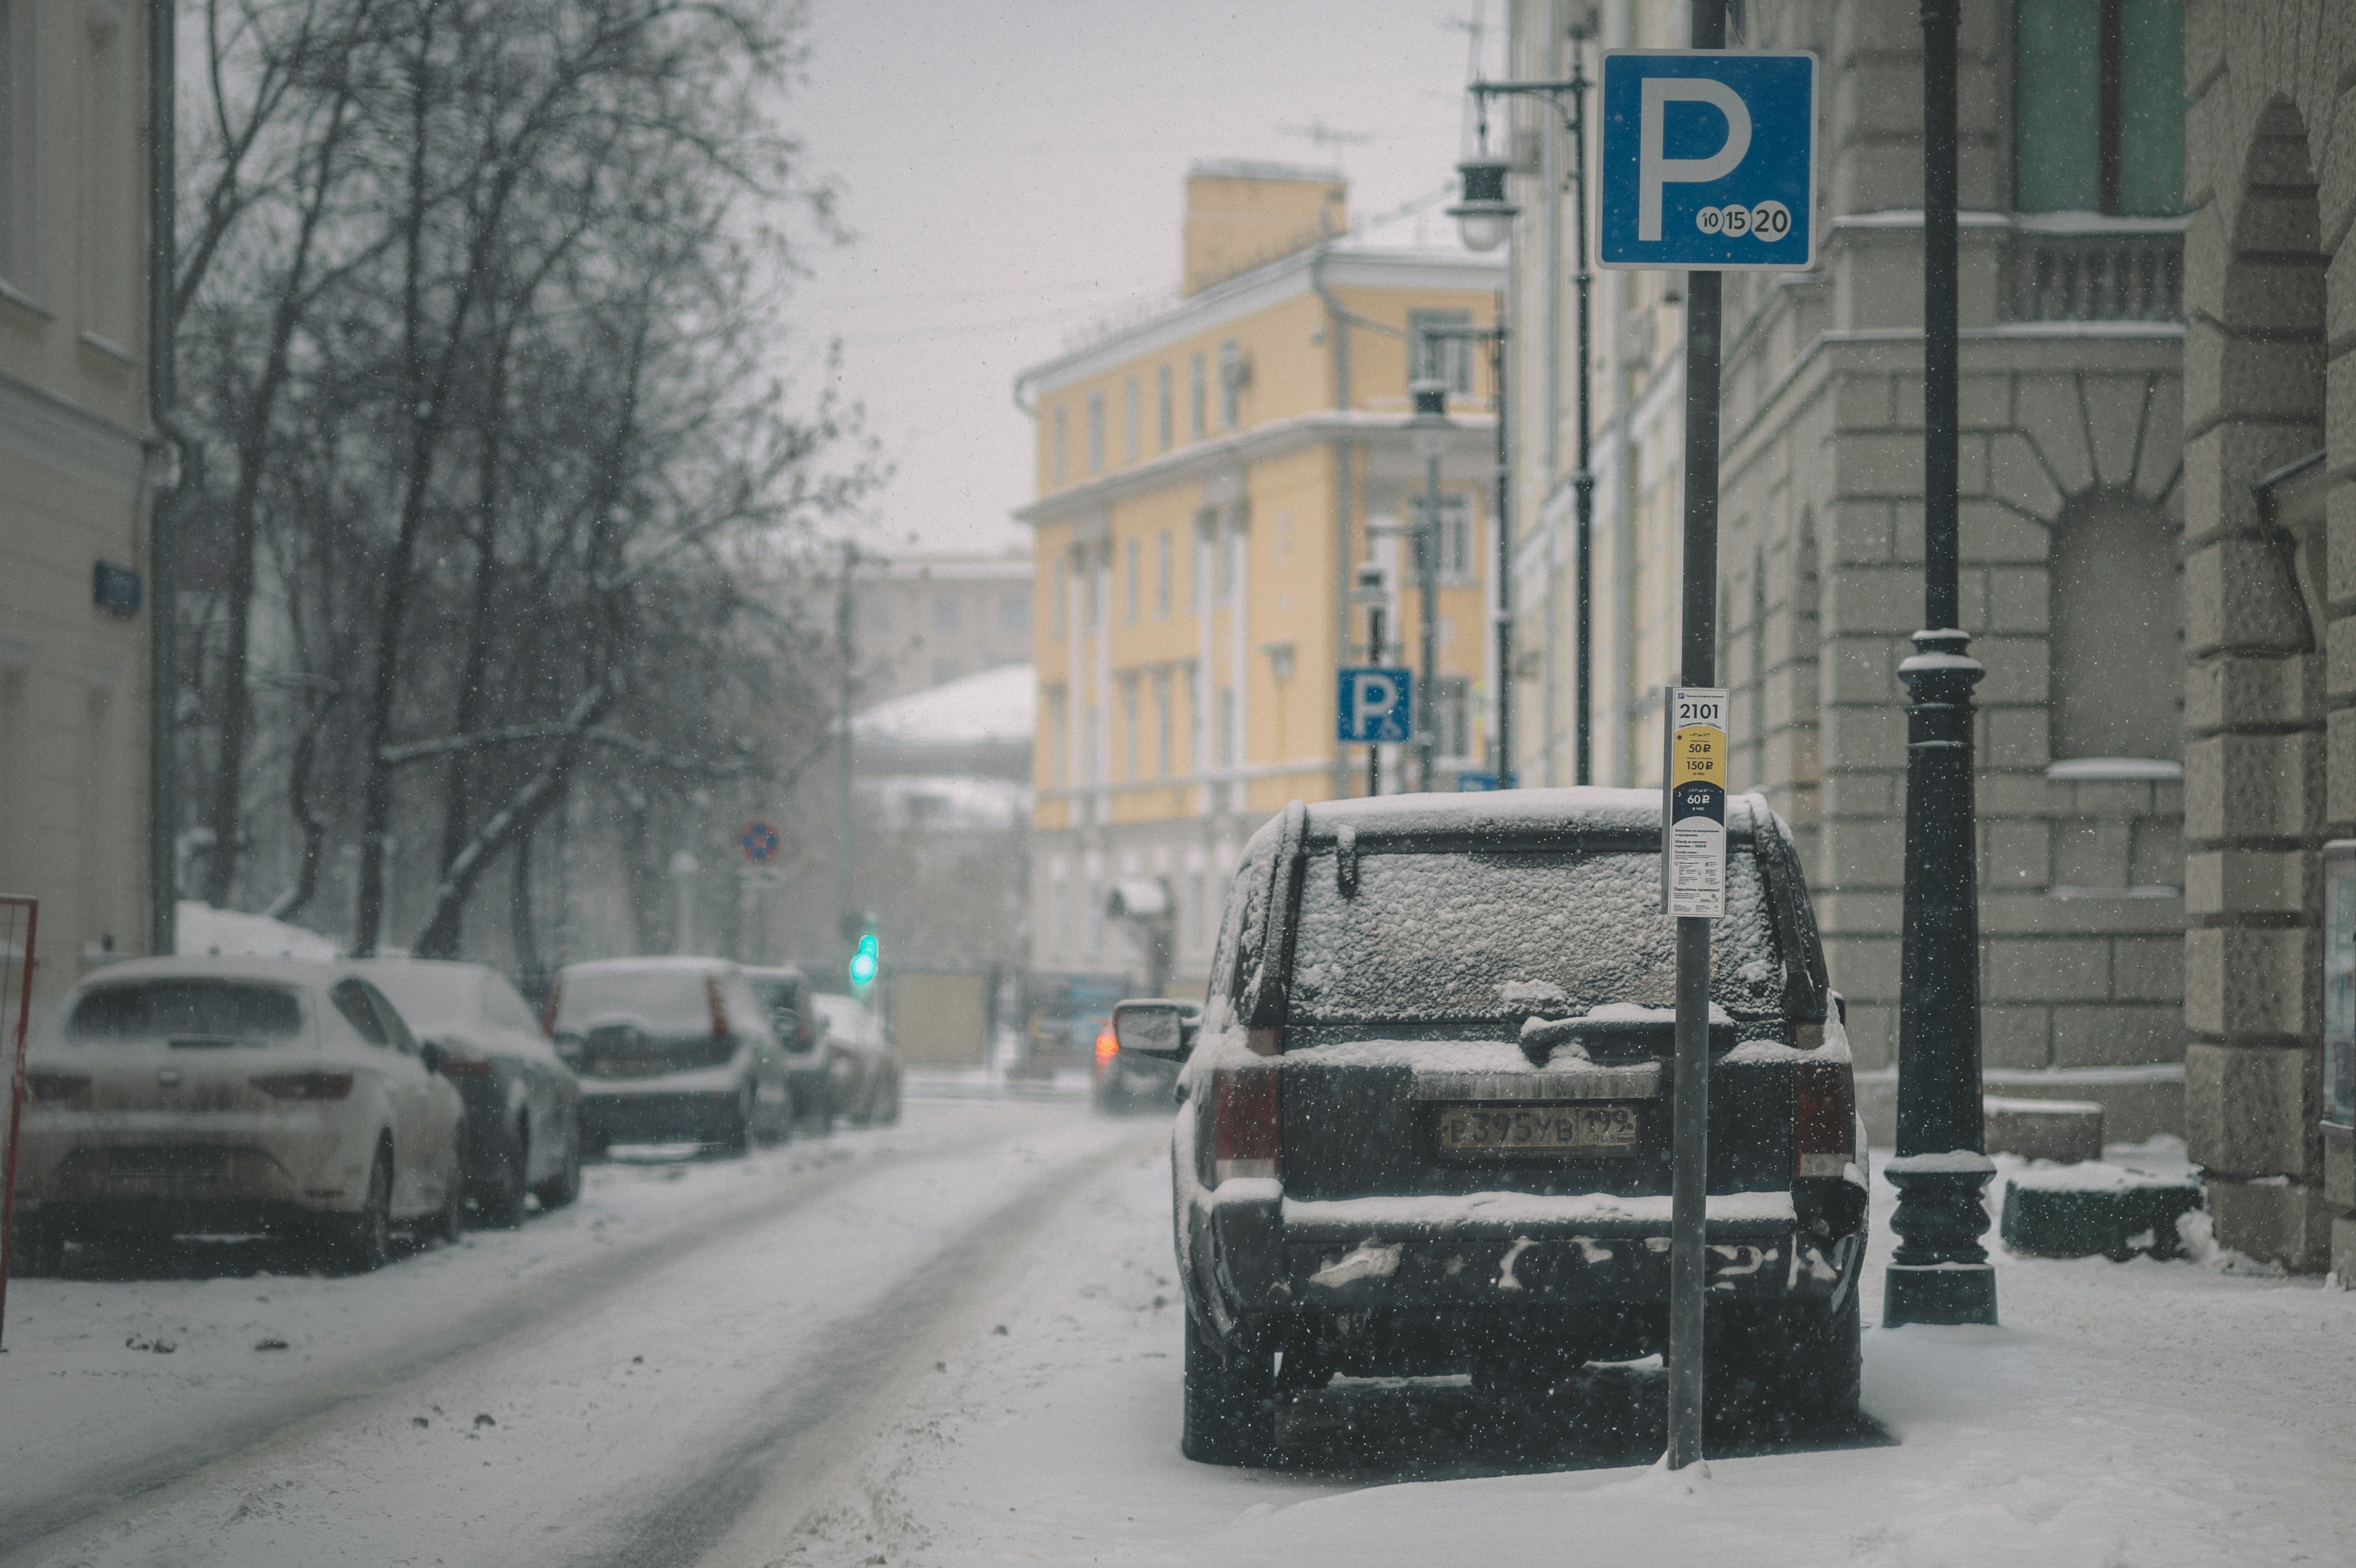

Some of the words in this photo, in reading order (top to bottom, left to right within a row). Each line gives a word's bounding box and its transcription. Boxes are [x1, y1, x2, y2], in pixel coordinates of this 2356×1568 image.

[1638, 77, 1752, 241] P
[1702, 212, 1718, 227] 10
[1726, 211, 1745, 229] 15
[1755, 209, 1788, 232] 20
[1352, 674, 1398, 737] P
[1680, 704, 1718, 719] 2101
[1689, 744, 1702, 753] 50
[1687, 761, 1704, 770] 150
[1687, 795, 1701, 804] 60
[1582, 1109, 1629, 1133] 199
[1592, 1135, 1616, 1143] RUS
